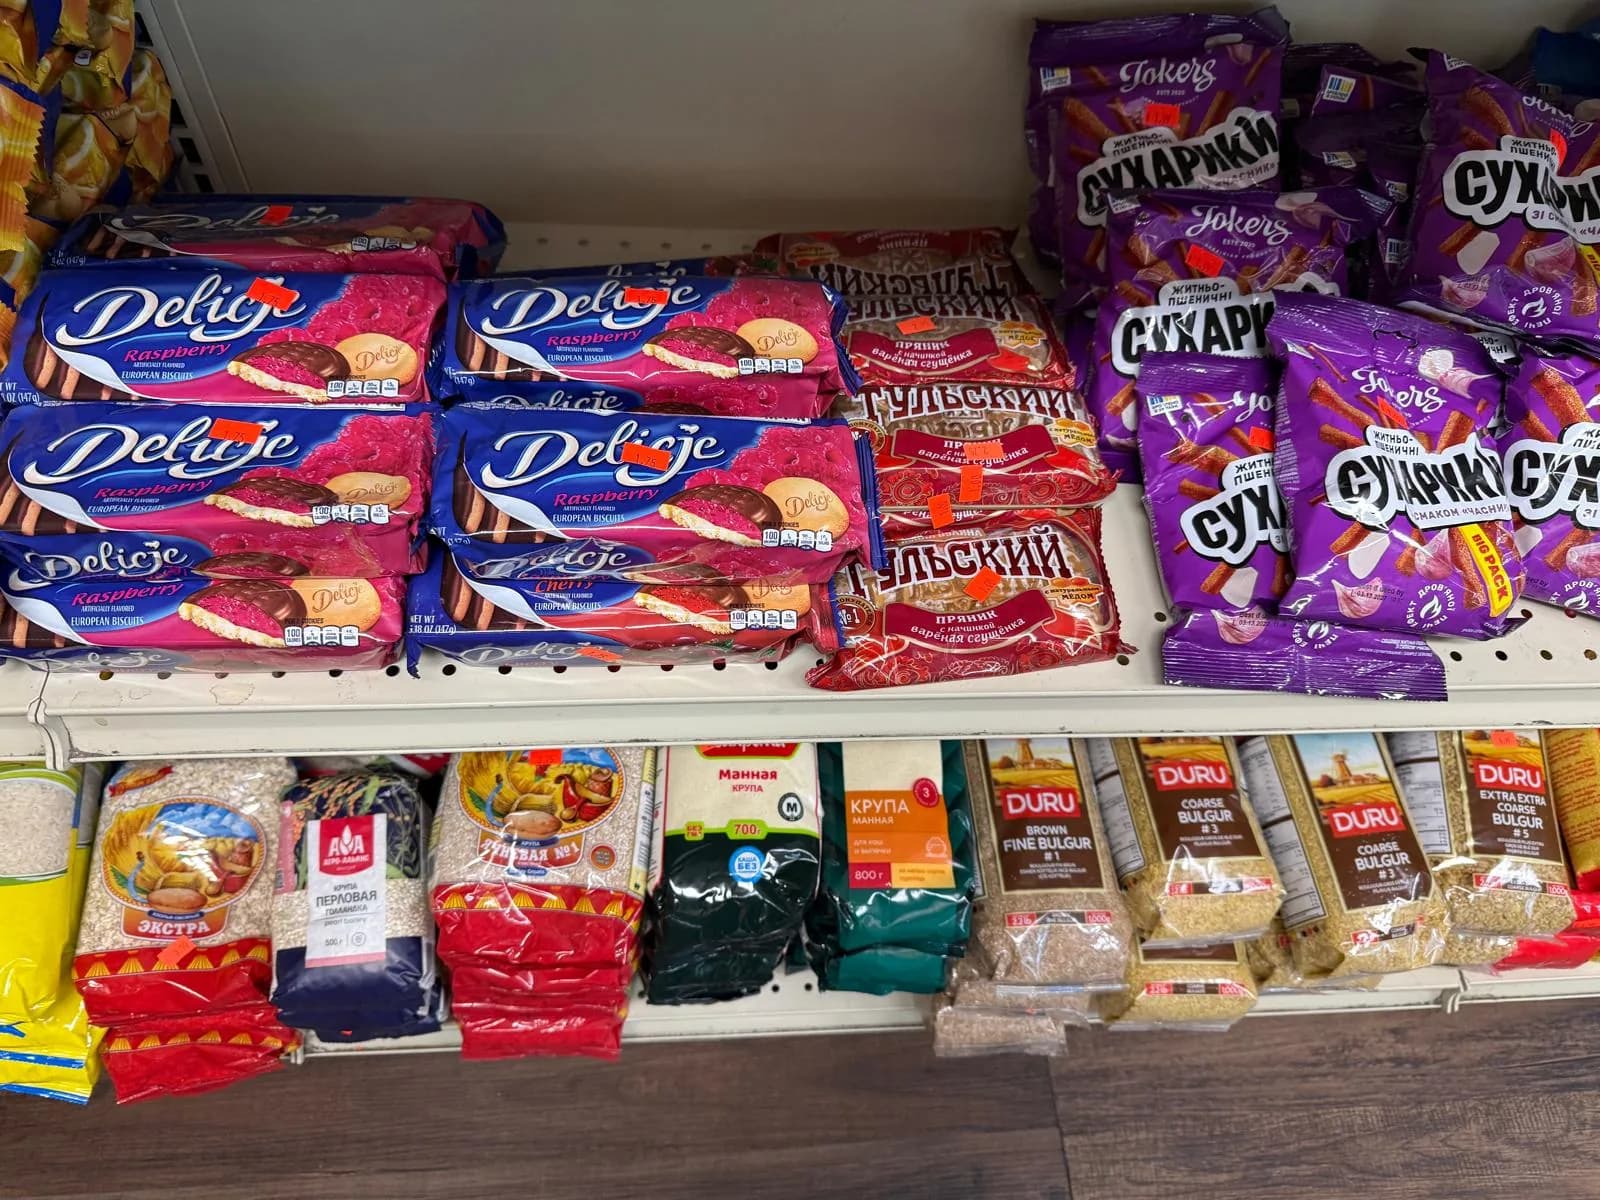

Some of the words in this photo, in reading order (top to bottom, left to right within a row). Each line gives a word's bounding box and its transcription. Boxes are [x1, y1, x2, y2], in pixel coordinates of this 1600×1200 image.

[1119, 56, 1217, 93] Jokers
[1082, 115, 1279, 215] СУХАРИКИ
[110, 204, 340, 231] Delje
[1185, 204, 1293, 246] Jokers
[1171, 282, 1225, 296] ЖИТНЬО-
[1168, 291, 1232, 306] ПШЕНИЧНІ
[55, 273, 306, 346] Delicje
[481, 278, 702, 335] Delije
[848, 294, 1022, 322] УЛЬСКИЙ
[546, 329, 642, 347] Raspberry
[895, 340, 950, 350] ПРЯНИК
[123, 343, 231, 363] Raspberry
[547, 354, 583, 362] EUROPEAN
[584, 354, 613, 362] BISCUITS
[122, 371, 160, 380] EUROPEAN
[162, 371, 193, 380] BISCUITS
[18, 393, 40, 404] (147g)
[1373, 430, 1414, 445] ЖИТНЬО-
[23, 415, 300, 485] Delicje
[94, 479, 213, 499] Raspberry
[554, 488, 660, 507] Raspberry
[87, 505, 130, 513] EUROPEAN
[132, 504, 166, 512] BISCUITS
[1414, 509, 1460, 521] СМАКОМ
[553, 514, 592, 523] EUROPEAN
[593, 514, 625, 523] BISCUITS
[765, 531, 778, 540] 100
[8, 540, 189, 592] Delicje
[841, 524, 1073, 598] ТУЛЬСКИЙ
[1471, 534, 1489, 555] BIG
[1484, 554, 1509, 603] PACK
[535, 578, 593, 593] Cherry
[72, 583, 184, 606] Raspberry
[534, 602, 571, 611] EUROPEAN
[572, 601, 600, 610] BISCUITS
[71, 617, 109, 626] EUROPEAN
[112, 616, 145, 626] BISCUITS
[423, 615, 435, 623] WT
[732, 612, 745, 620] 100
[935, 609, 998, 625] ПРЯНИК
[286, 628, 301, 637] 100
[911, 626, 964, 644] варёная
[966, 617, 1026, 645] сгущёнка
[947, 622, 995, 634] начинкой
[718, 769, 778, 780] Манная
[1158, 765, 1228, 786] DURU
[1479, 764, 1541, 788] DURU
[732, 784, 764, 793] КРУПА
[922, 787, 930, 798] 3
[1006, 792, 1075, 814] DURU
[1181, 797, 1225, 809] COARSE
[1480, 790, 1517, 803] EXTRA
[1517, 793, 1547, 806] EXTRA
[851, 799, 910, 813] КРУПА
[1497, 802, 1537, 815] COARSE
[853, 816, 894, 824] МАННАЯ
[1177, 809, 1234, 823] BULGUR
[1332, 806, 1400, 832] DURU
[1492, 812, 1544, 830] BULGUR
[1026, 825, 1068, 836] BROWN
[1212, 824, 1219, 833] 3
[1522, 829, 1530, 839] 5
[1003, 839, 1037, 853] FINE
[1038, 836, 1093, 851] BULGUR
[1357, 841, 1400, 855] COARSE
[737, 862, 757, 870] БЕЗ
[1354, 852, 1411, 871] BULGUR
[855, 870, 876, 880] 800
[1388, 868, 1396, 879] 3
[316, 890, 377, 907] ПЕРЛОВАЯ
[137, 919, 211, 935] ЭКСТРА
